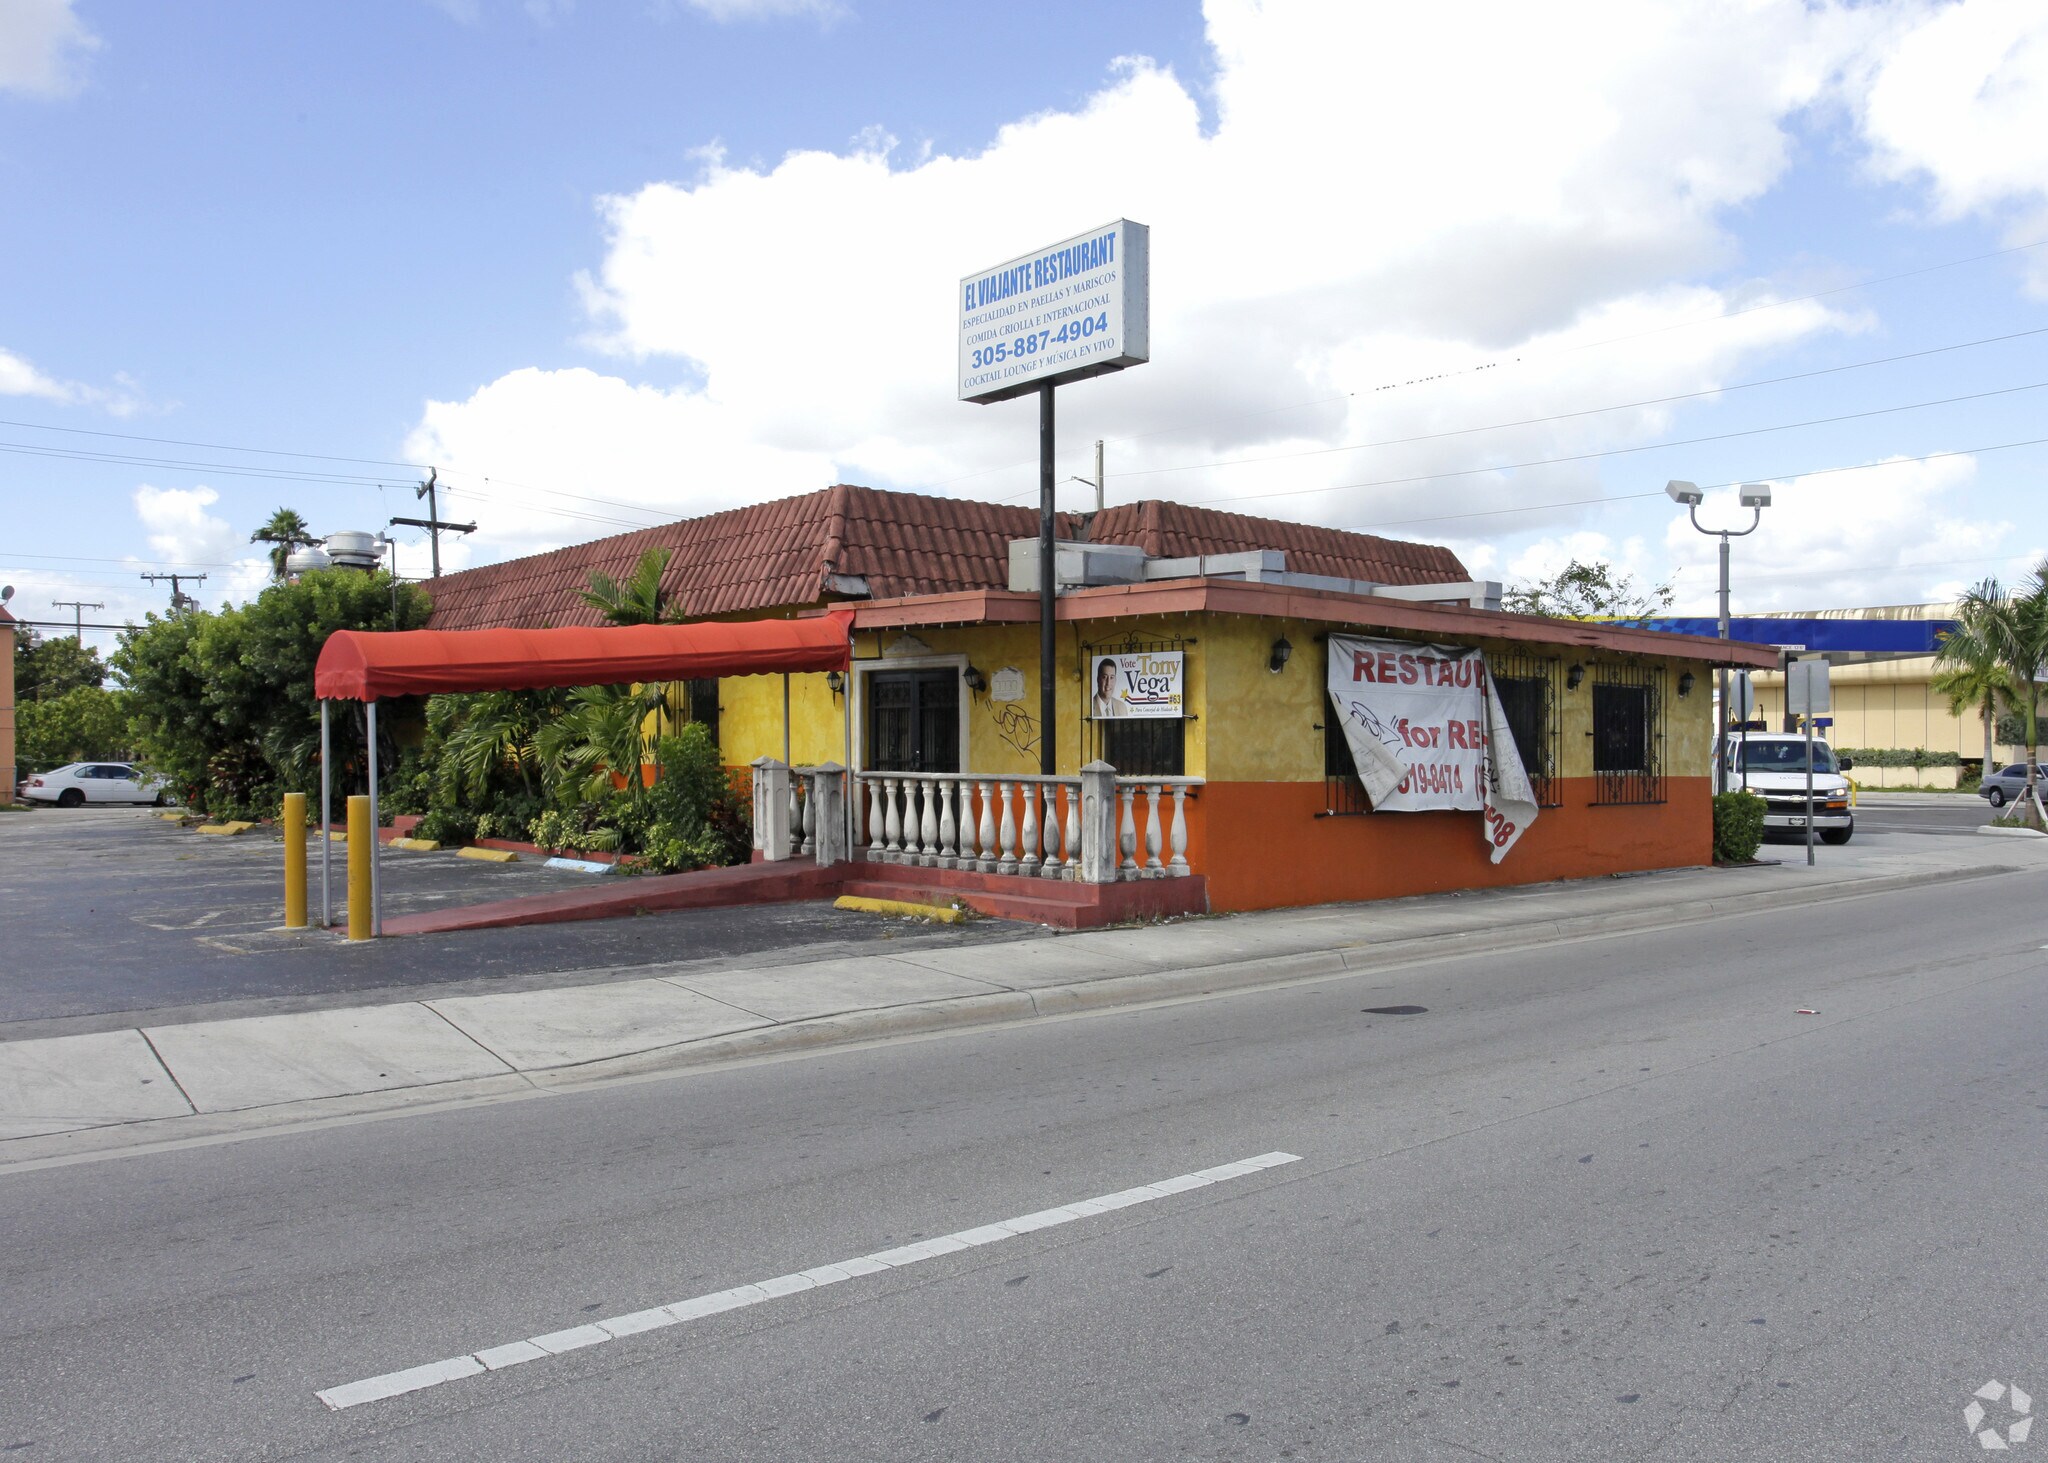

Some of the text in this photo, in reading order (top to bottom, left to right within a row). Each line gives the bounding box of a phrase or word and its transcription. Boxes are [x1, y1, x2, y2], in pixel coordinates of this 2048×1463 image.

[965, 231, 1116, 312] EL VIAJANTE RESTAURANT
[962, 270, 1117, 330] ESPECIALIDAD EN PAELLAS Y MARISCOS
[966, 293, 1111, 346] COMIDA CRIOLLA E INTERNACIONAL
[964, 336, 1115, 389] COCKTAIL LOUNGE Y MÚSICA EN VIVO
[971, 311, 1108, 370] 305-887-4904
[1120, 655, 1180, 681] Vote Tony
[1124, 670, 1171, 702] Vega
[1397, 718, 1441, 749] for
